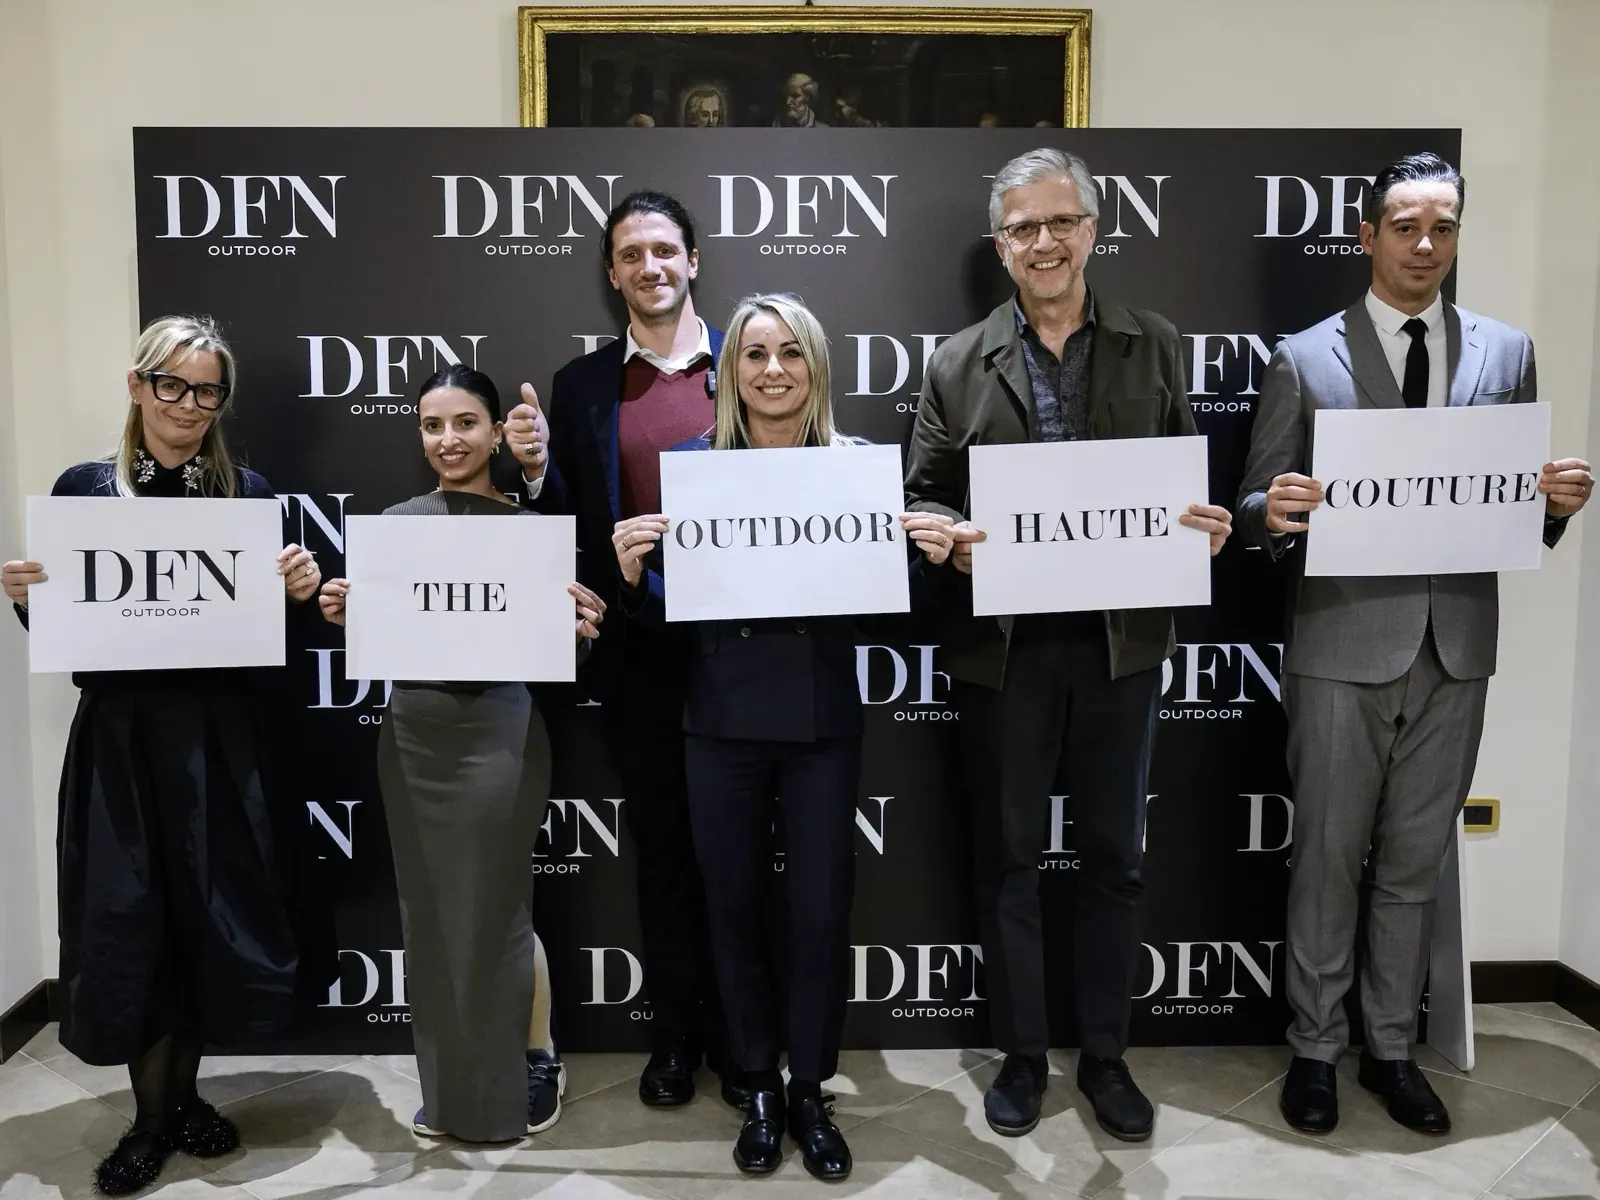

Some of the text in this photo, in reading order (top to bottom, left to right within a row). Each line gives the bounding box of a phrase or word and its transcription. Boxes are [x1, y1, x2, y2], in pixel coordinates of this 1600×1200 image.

[153, 175, 346, 239] DFN
[432, 175, 624, 238] DFN
[708, 174, 898, 238] DFN
[1253, 175, 1375, 238] DF
[208, 245, 296, 256] OUTDOOR
[484, 244, 572, 256] OUTDOOR
[759, 244, 847, 255] OUTDOOR
[1303, 244, 1364, 256] OUTDO
[350, 404, 417, 415] OUTDO
[1190, 402, 1251, 412] TDOOR
[1324, 472, 1539, 509] COUTURE
[675, 512, 896, 550] OUTDOOR
[1013, 506, 1169, 544] HAUTE
[72, 550, 245, 603] DFN
[413, 582, 507, 612] THE
[121, 608, 200, 617] OUTDOOR
[855, 645, 952, 704] DF
[1162, 643, 1285, 703] FN
[893, 711, 959, 721] OUTDO
[1159, 709, 1243, 719] OUTDOOR
[532, 864, 580, 874] DOOR
[891, 1007, 975, 1017] OUTDOOR
[1151, 1004, 1234, 1015] OUTDOOR
[367, 1013, 412, 1023] OUTD
